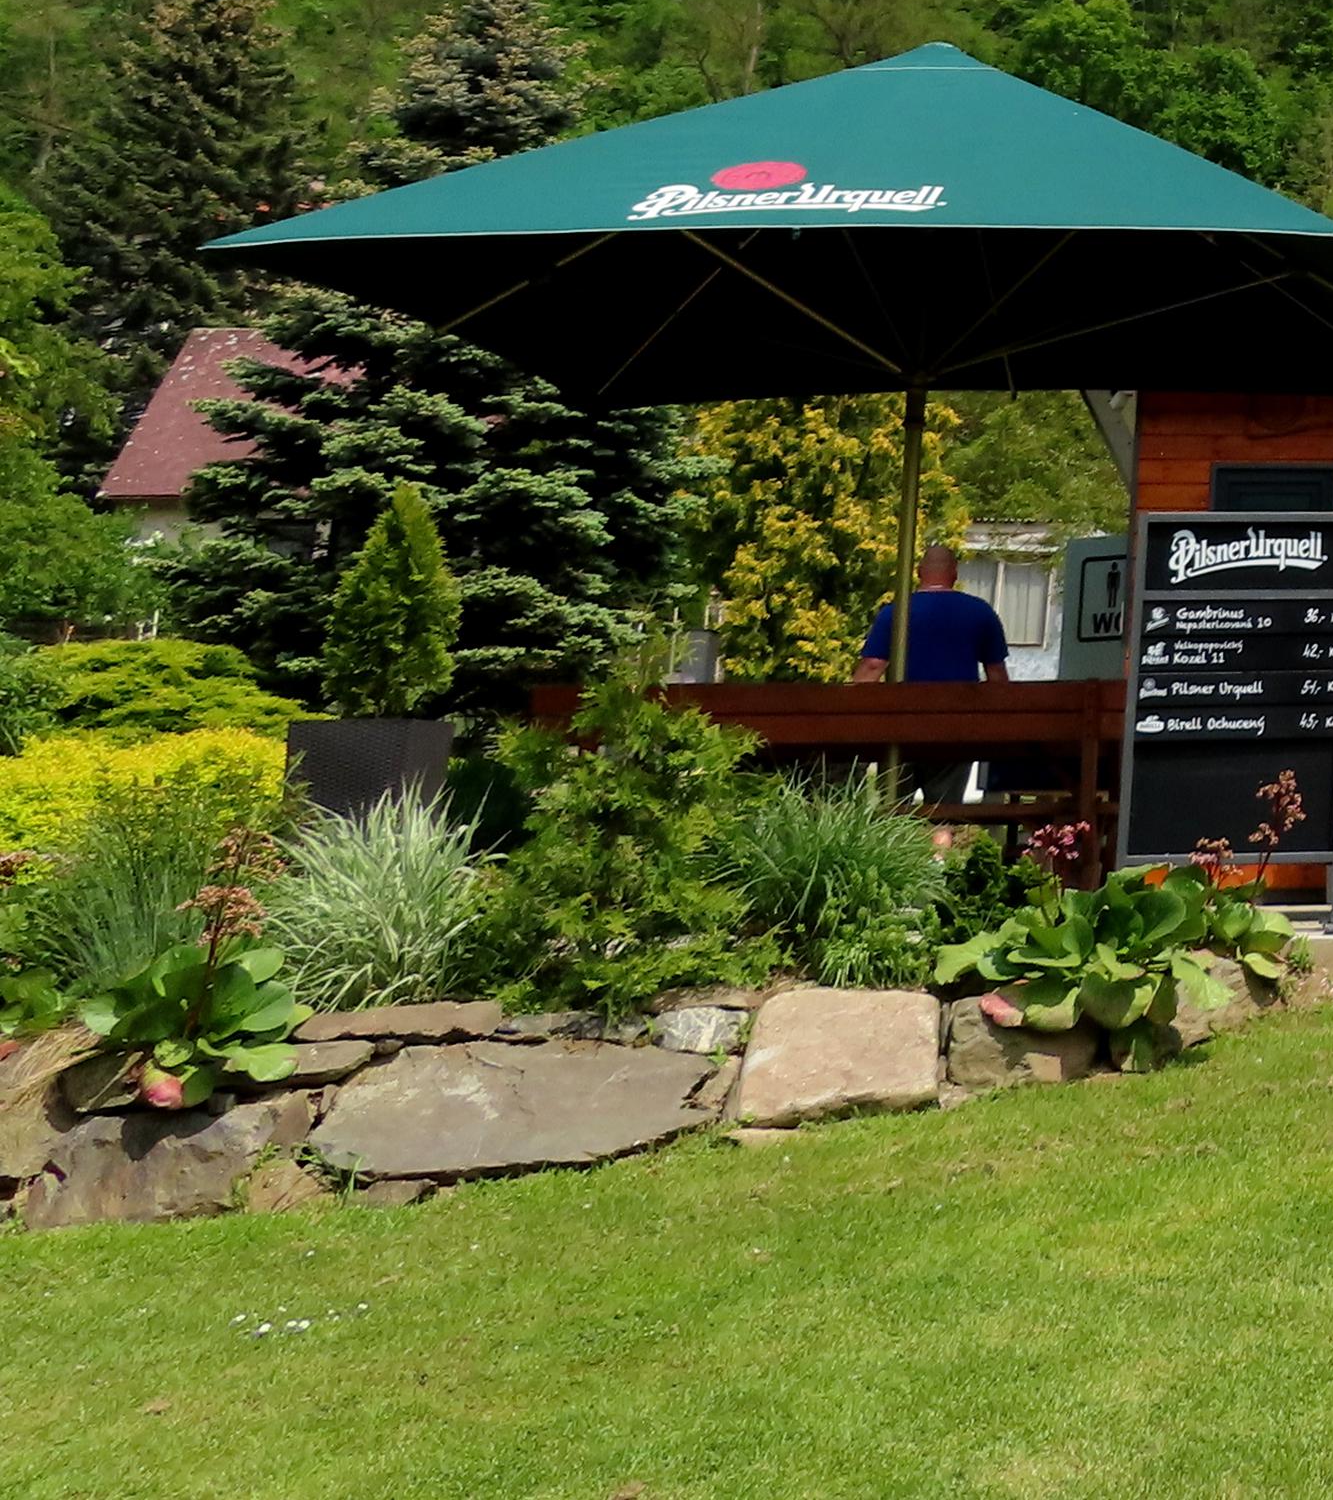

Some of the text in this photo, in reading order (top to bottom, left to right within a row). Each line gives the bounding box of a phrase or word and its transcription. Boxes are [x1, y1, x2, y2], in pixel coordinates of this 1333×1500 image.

[1176, 605, 1244, 620] Gambrinus
[1257, 617, 1272, 628] 10
[1172, 651, 1207, 665] Kozel
[1210, 651, 1225, 664] 11
[1171, 681, 1216, 695] Pilsner
[1218, 680, 1264, 700] Urquell
[1167, 717, 1203, 732] Birell
